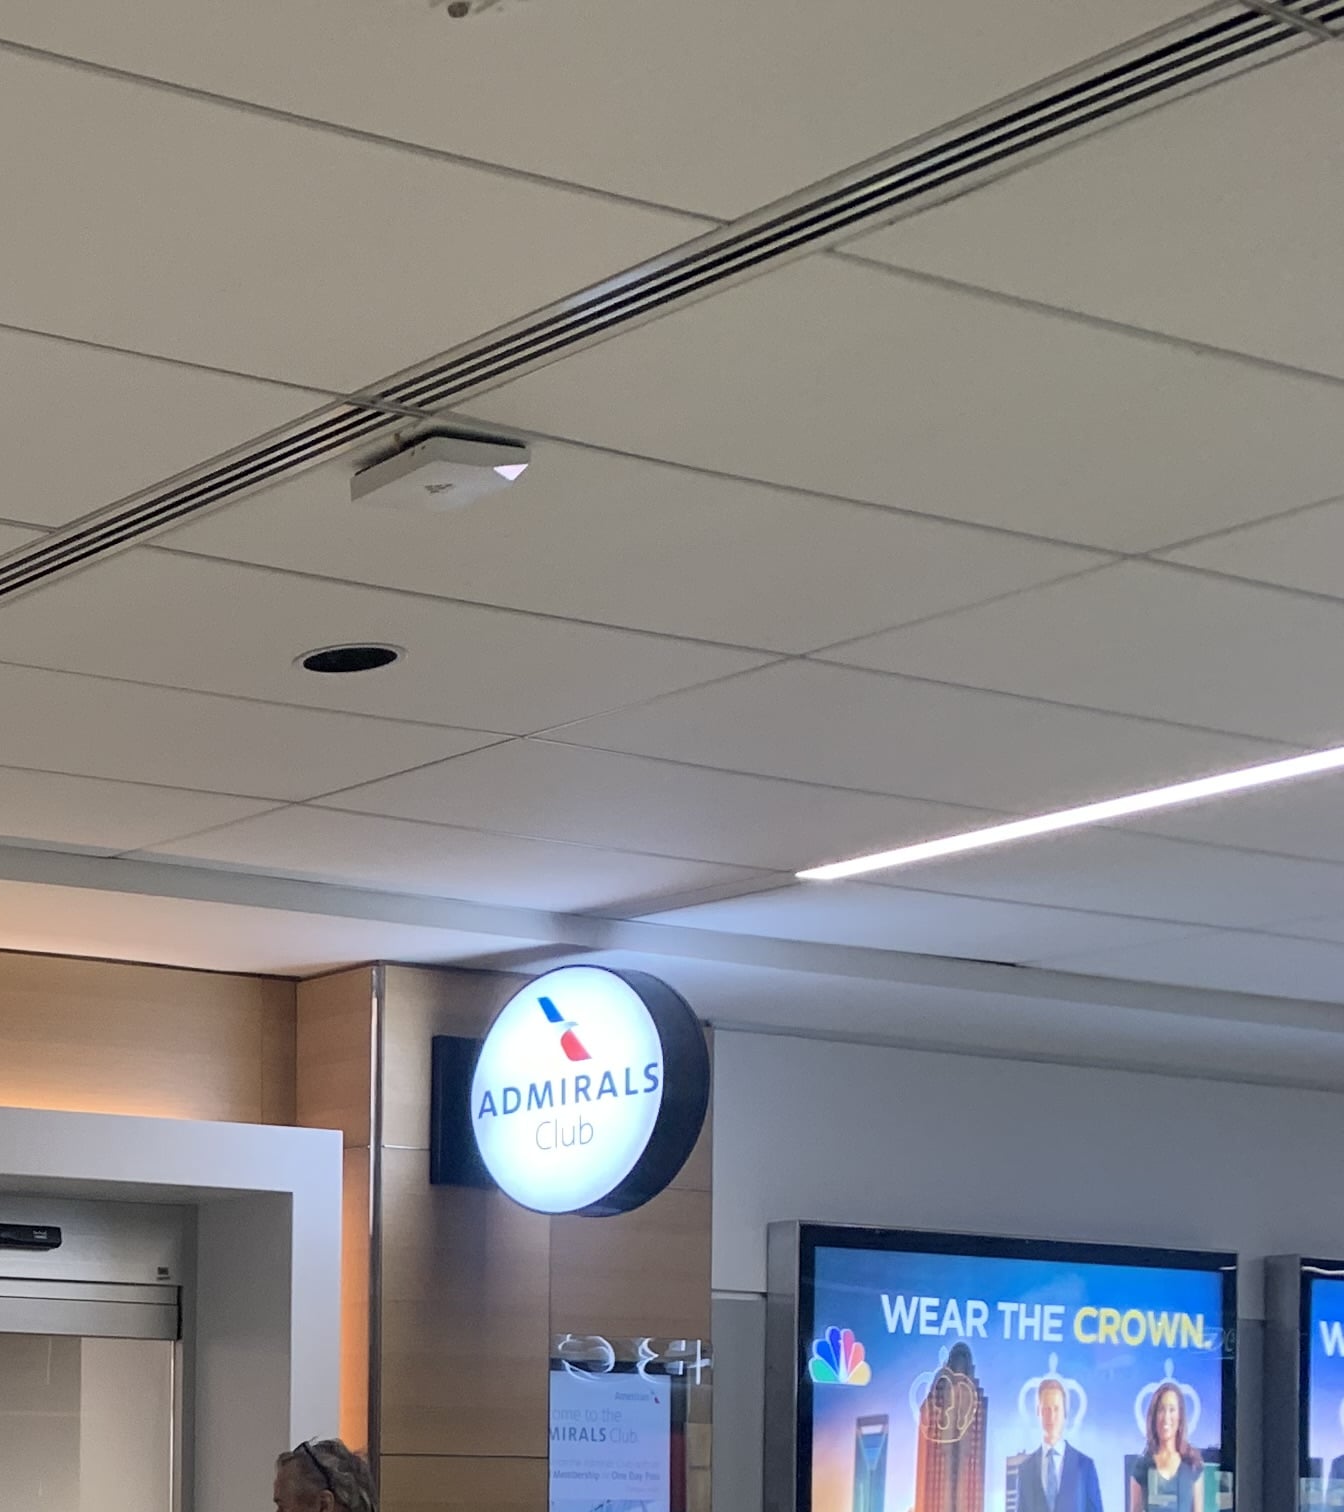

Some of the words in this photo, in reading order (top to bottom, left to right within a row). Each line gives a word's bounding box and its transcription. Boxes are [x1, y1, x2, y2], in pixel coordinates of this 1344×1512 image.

[478, 1062, 659, 1119] ADMIRALS
[535, 1114, 594, 1150] Club
[880, 1294, 989, 1339] WEAR
[997, 1301, 1065, 1342] THE
[1073, 1306, 1212, 1349] CROWN.
[585, 1409, 598, 1422] to
[601, 1408, 622, 1422] the
